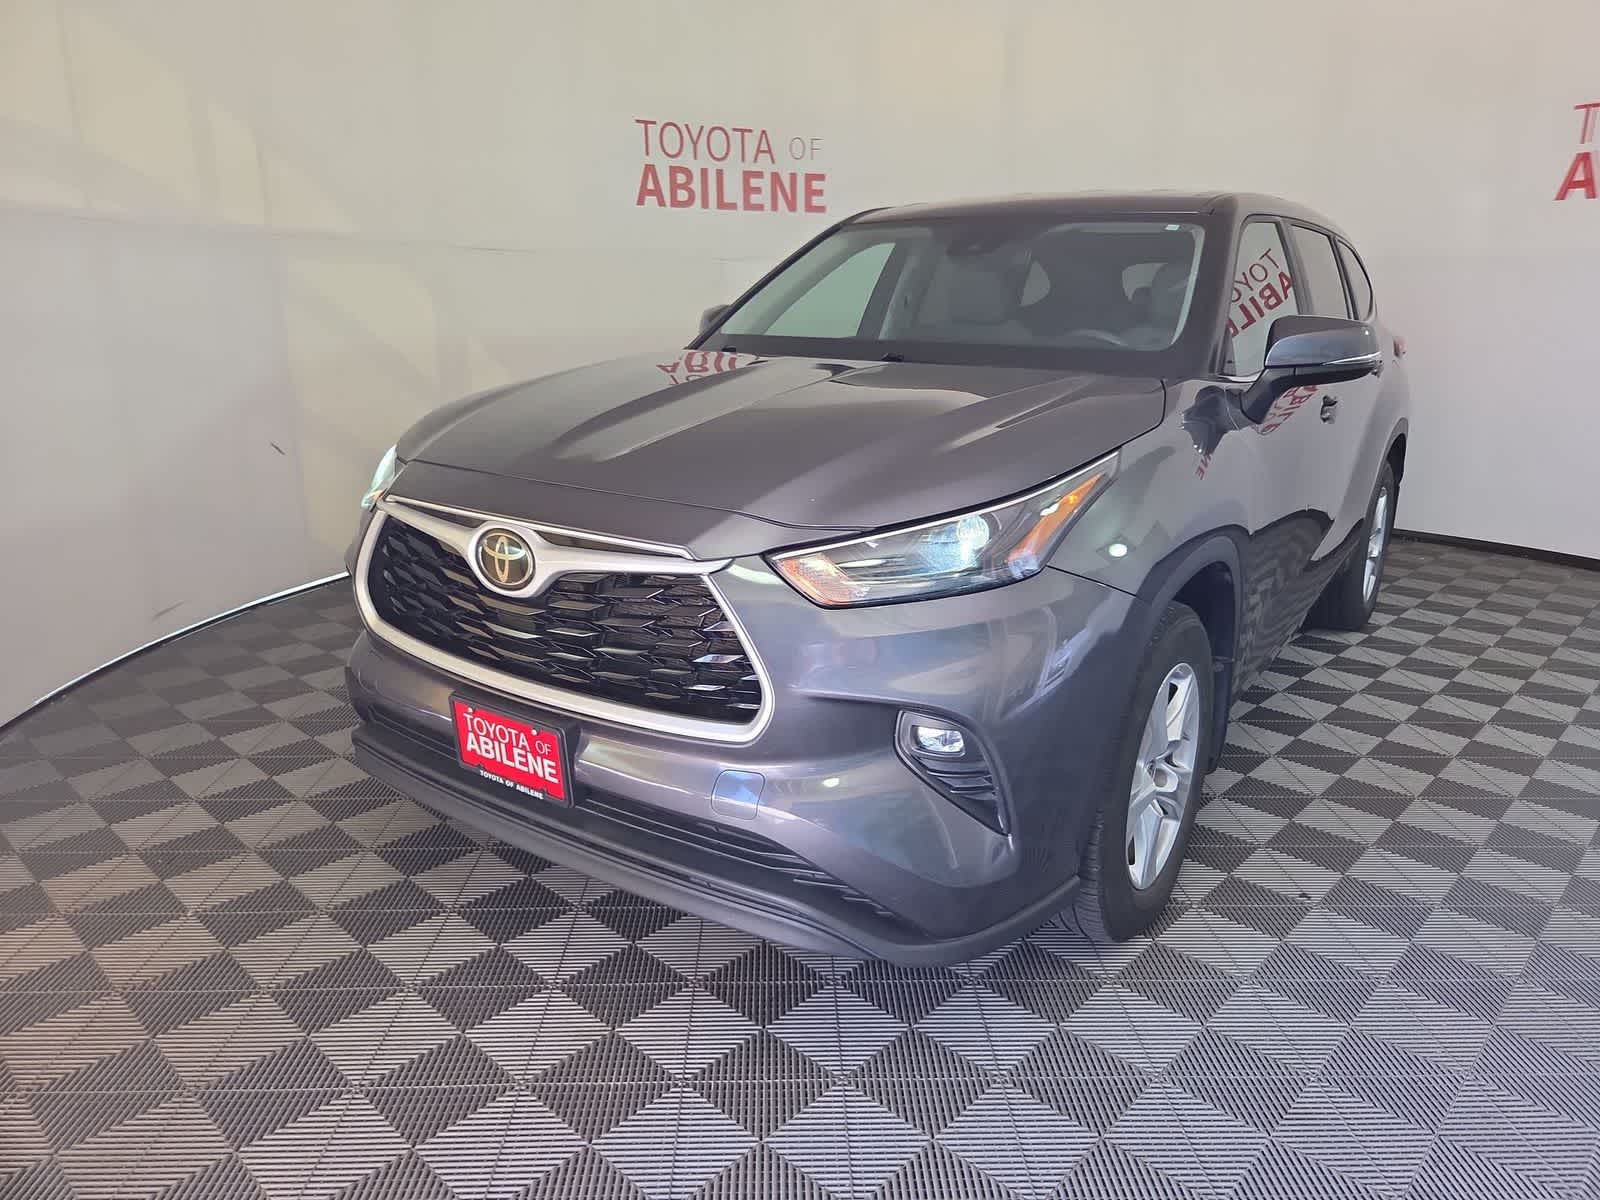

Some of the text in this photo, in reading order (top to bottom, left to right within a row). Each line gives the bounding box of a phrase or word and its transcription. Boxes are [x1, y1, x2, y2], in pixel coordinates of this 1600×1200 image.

[634, 119, 824, 164] TOYOTA OF
[635, 163, 827, 214] ABILENE
[463, 712, 552, 755] TOYOTA OF
[466, 732, 559, 784] ABILENE
[479, 769, 544, 800] TOYOTA OF ABILENE
